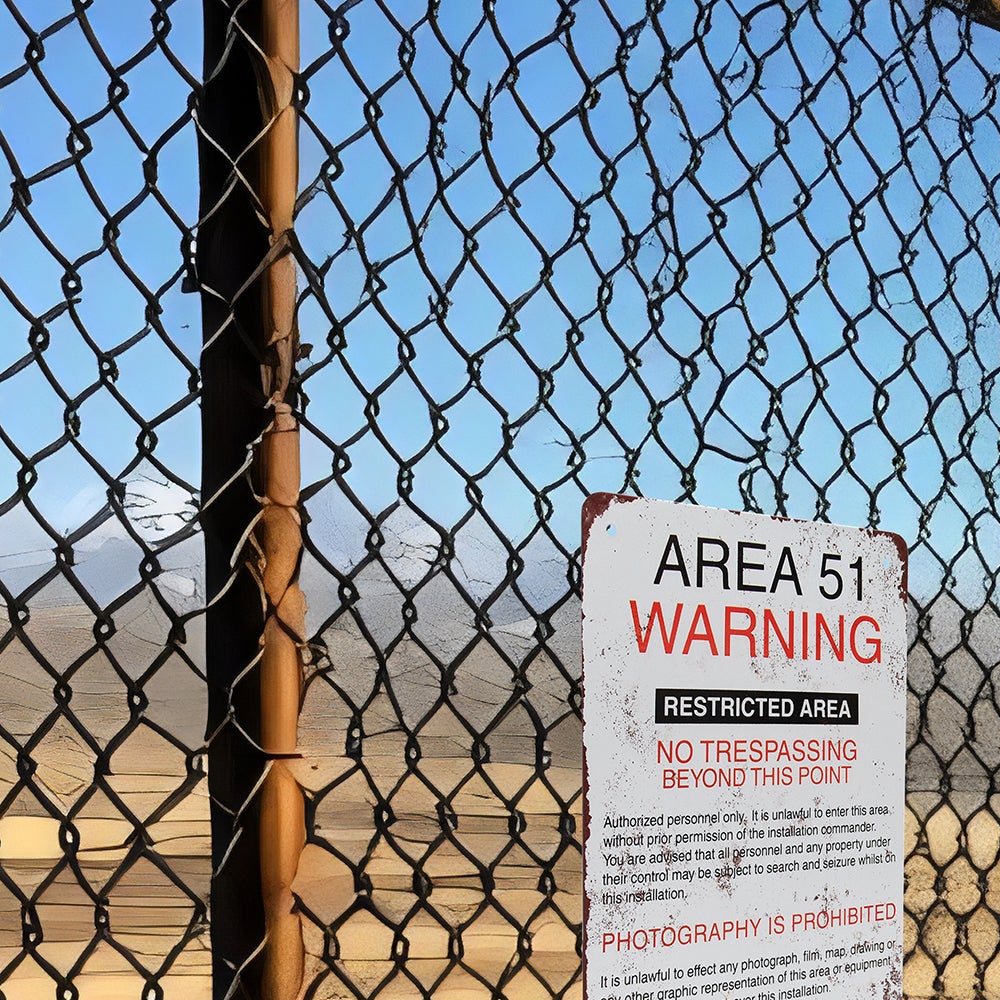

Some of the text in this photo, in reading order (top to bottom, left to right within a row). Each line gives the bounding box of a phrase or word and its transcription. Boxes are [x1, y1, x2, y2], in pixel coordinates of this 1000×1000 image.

[653, 534, 863, 601] AREA 51
[629, 600, 882, 664] WARNING
[664, 696, 851, 719] RESTRICTED AREA
[656, 739, 858, 764] NO TRESPASSING
[662, 765, 852, 789] BEYOND THIS POINT
[603, 814, 664, 829] Authorized
[667, 812, 721, 828] personnel
[752, 809, 758, 821] It
[761, 808, 769, 821] is
[772, 807, 812, 820] unlawful
[814, 808, 823, 818] to
[825, 806, 850, 817] enter
[851, 804, 867, 816] this
[603, 822, 877, 848] without prior permission of the installation commander.
[603, 853, 624, 866] You
[627, 854, 646, 866] are
[695, 848, 715, 860] that
[718, 846, 730, 859] all
[732, 844, 783, 863] personnel
[785, 842, 804, 854] and
[806, 841, 824, 855] any
[825, 838, 864, 853] property
[865, 836, 891, 848] under
[602, 852, 896, 886] their control may be subject to search and seizure whilst on
[602, 887, 688, 905] this installation.
[602, 902, 897, 953] PHOTOGRAPHY IS PROHIBITED
[600, 975, 608, 988] It
[611, 974, 621, 987] is
[624, 968, 671, 986] unlawful
[673, 967, 685, 980] to
[687, 963, 717, 977] effect
[719, 962, 739, 975] any
[741, 952, 801, 973] photograph,
[803, 949, 823, 962] film,
[850, 941, 885, 957] drawing
[886, 939, 896, 949] or
[700, 974, 775, 995] representation
[777, 971, 787, 983] of
[789, 968, 807, 981] this
[808, 966, 830, 978] area
[832, 964, 843, 975] or
[778, 983, 832, 1000] installation.
